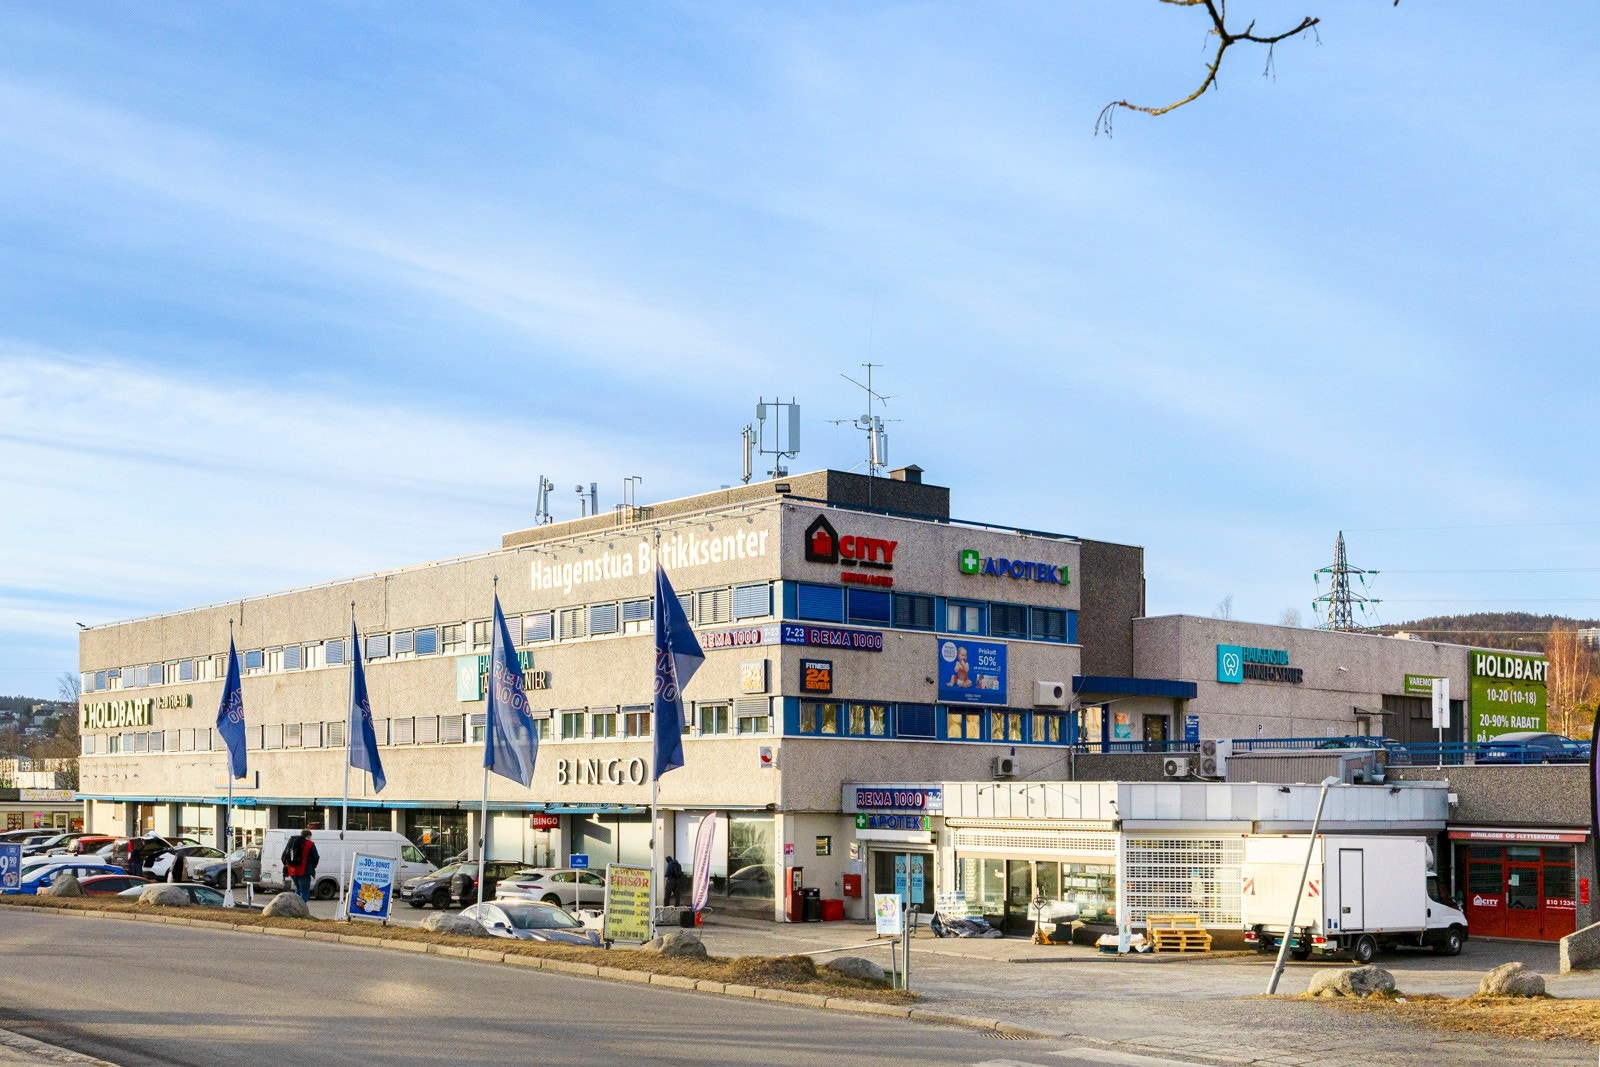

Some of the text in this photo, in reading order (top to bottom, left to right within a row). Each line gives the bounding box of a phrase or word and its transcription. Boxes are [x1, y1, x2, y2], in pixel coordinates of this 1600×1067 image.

[839, 535, 898, 563] CITY
[530, 551, 633, 594] Haugenstua
[982, 557, 1071, 585] APOTEK 1
[701, 629, 759, 649] REMA 1000
[764, 627, 779, 637] 7-23
[785, 627, 805, 637] 7-23
[811, 630, 882, 649] REMA 1000
[805, 662, 830, 670] FITNESS
[978, 656, 997, 667] 50%
[1476, 654, 1549, 681] HOLDBART
[806, 669, 830, 682] 24
[806, 681, 830, 690] SEVEN
[1487, 689, 1537, 706] 10-20 (10-18)
[88, 697, 151, 729] HOLDBART
[1479, 713, 1540, 730] 20-90% RABATT
[557, 757, 645, 785] BINGO
[857, 792, 892, 806] REMA
[894, 792, 922, 807] 1000
[533, 817, 558, 826] BINGO
[869, 815, 931, 831] APOTEK 1
[610, 875, 649, 888] FRISØR
